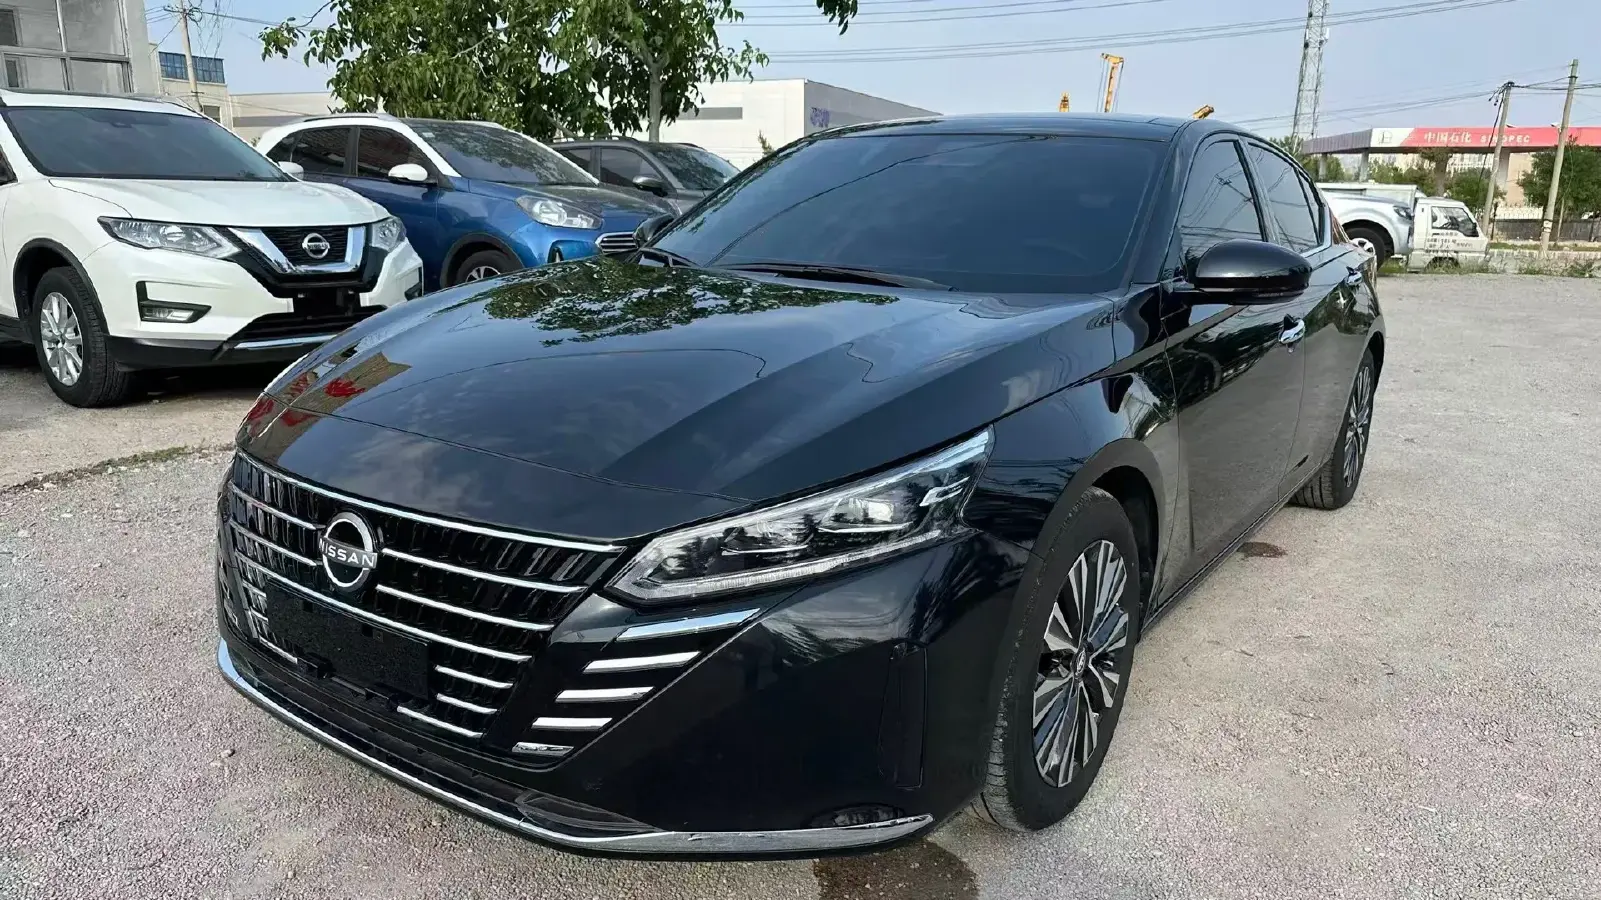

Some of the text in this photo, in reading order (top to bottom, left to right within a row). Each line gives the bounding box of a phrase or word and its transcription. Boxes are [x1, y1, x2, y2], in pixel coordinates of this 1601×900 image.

[1424, 131, 1472, 143] 中国石化
[318, 538, 375, 567] NISSAN
